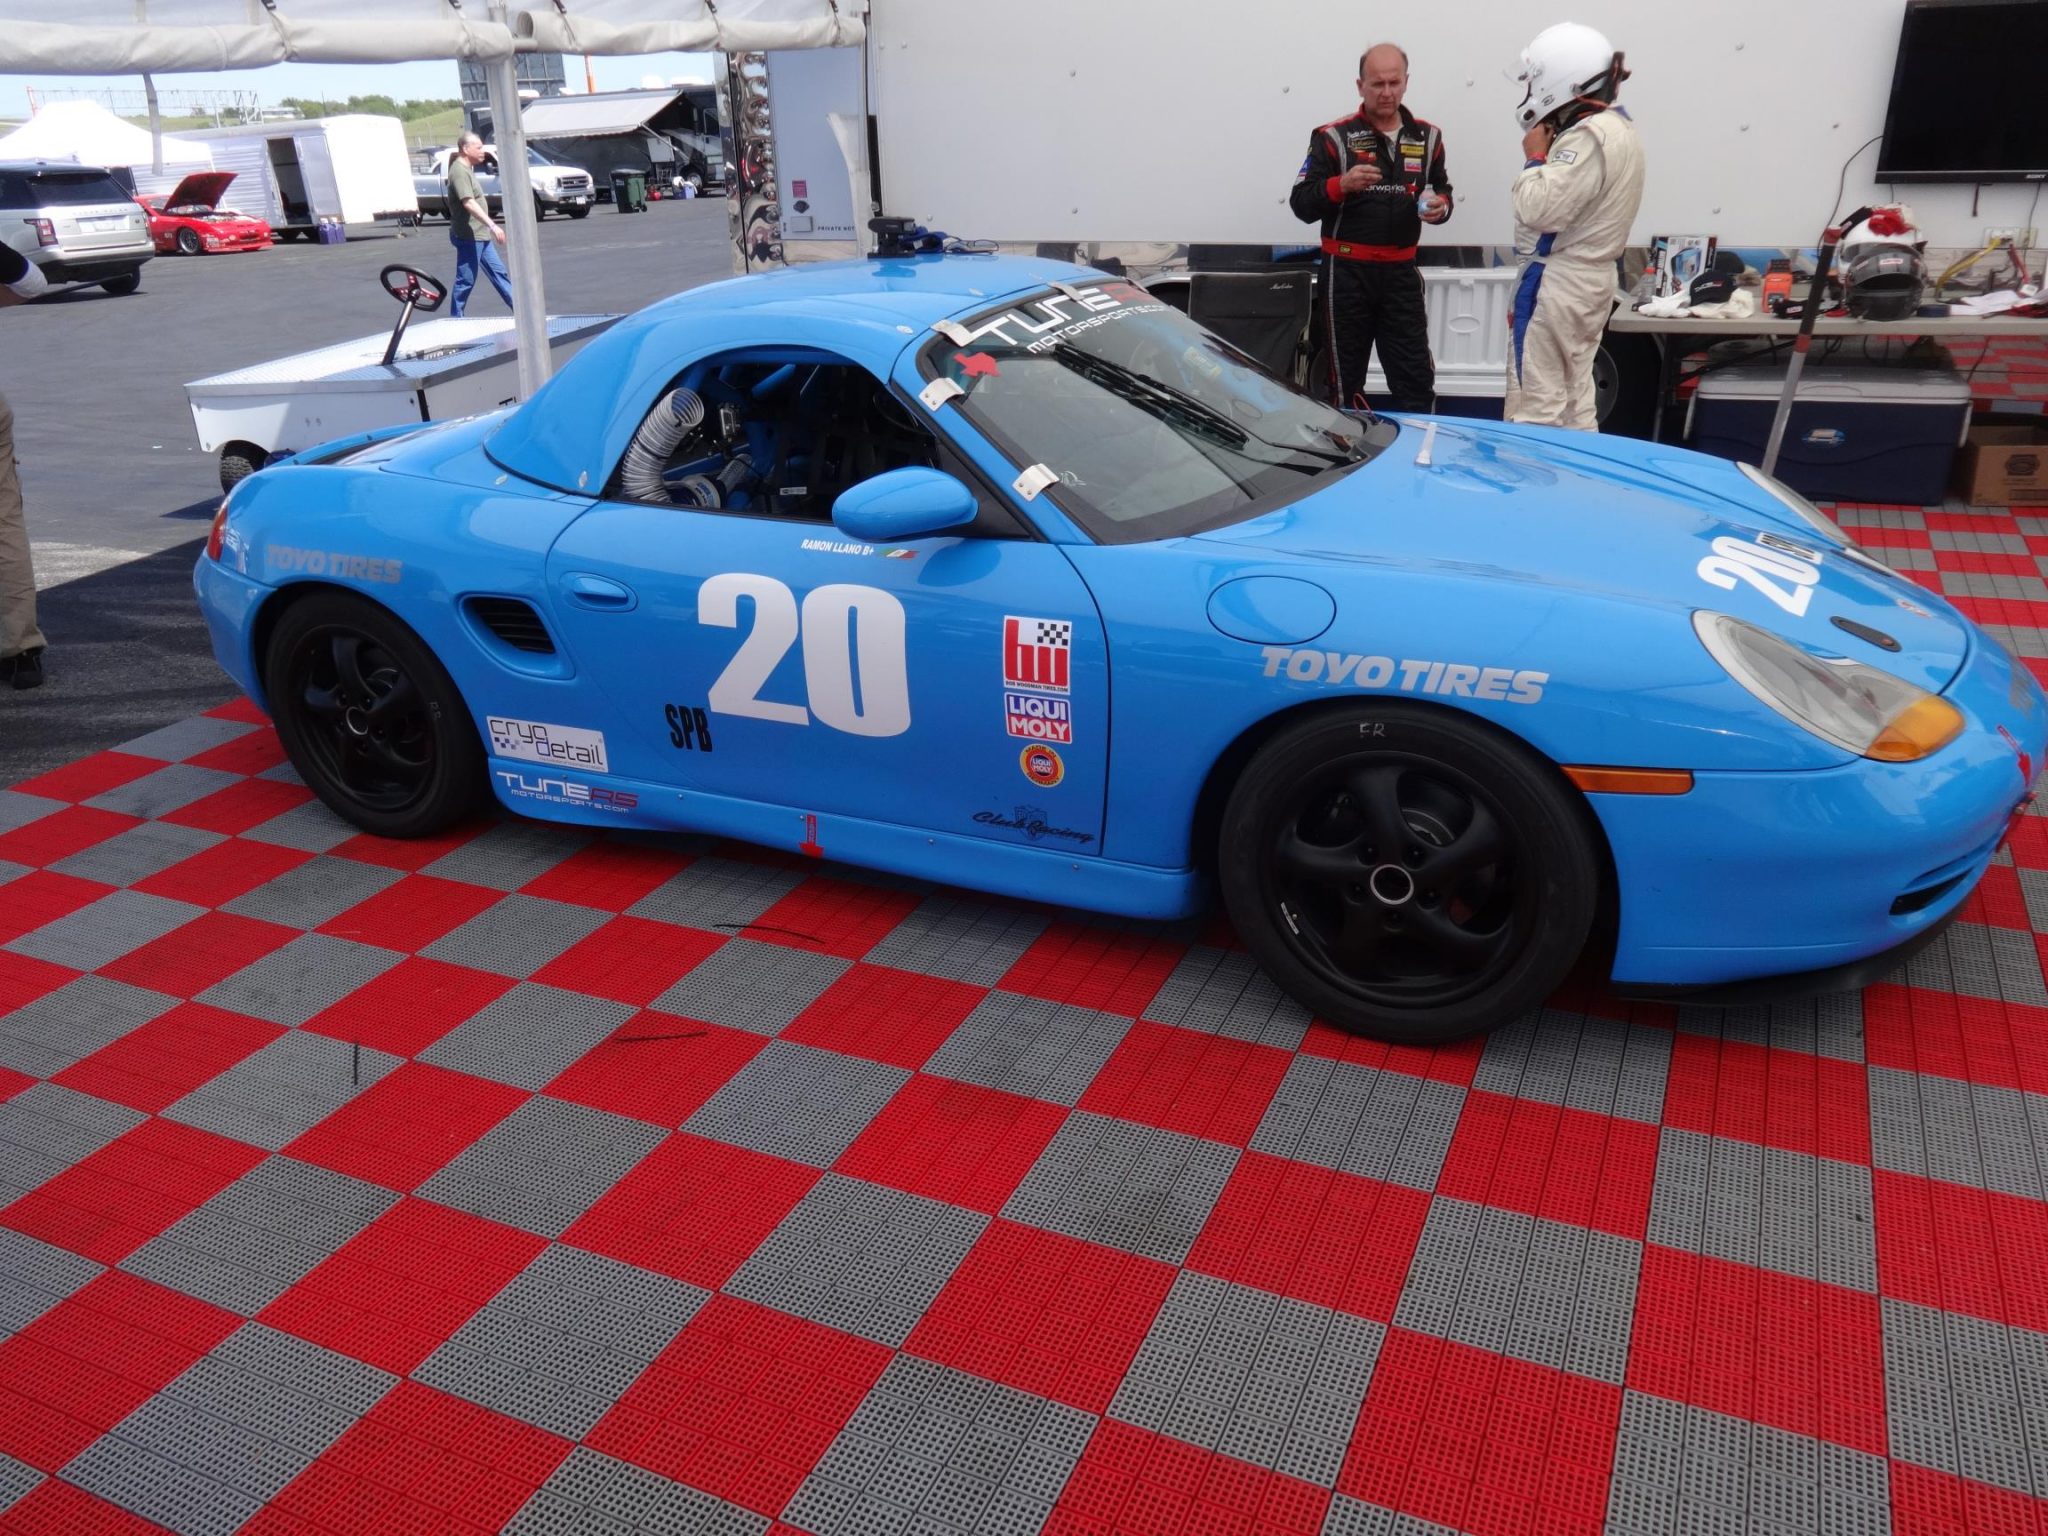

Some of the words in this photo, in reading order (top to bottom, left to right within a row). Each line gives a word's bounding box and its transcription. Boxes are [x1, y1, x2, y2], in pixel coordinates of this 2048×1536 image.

[801, 538, 832, 552] RAMON
[832, 542, 861, 555] LLANO
[265, 543, 326, 575] TOYO
[330, 552, 403, 584] TIRES
[1697, 536, 1820, 617] 20
[697, 572, 912, 737] 20
[1261, 646, 1396, 689] TOYO
[1399, 659, 1550, 705] TIRES
[1009, 695, 1067, 720] LIQUI
[490, 719, 548, 744] cryo
[664, 703, 713, 752] SPB
[1010, 716, 1069, 740] MOLY
[535, 737, 604, 765] detail
[1026, 820, 1095, 844] Racing
